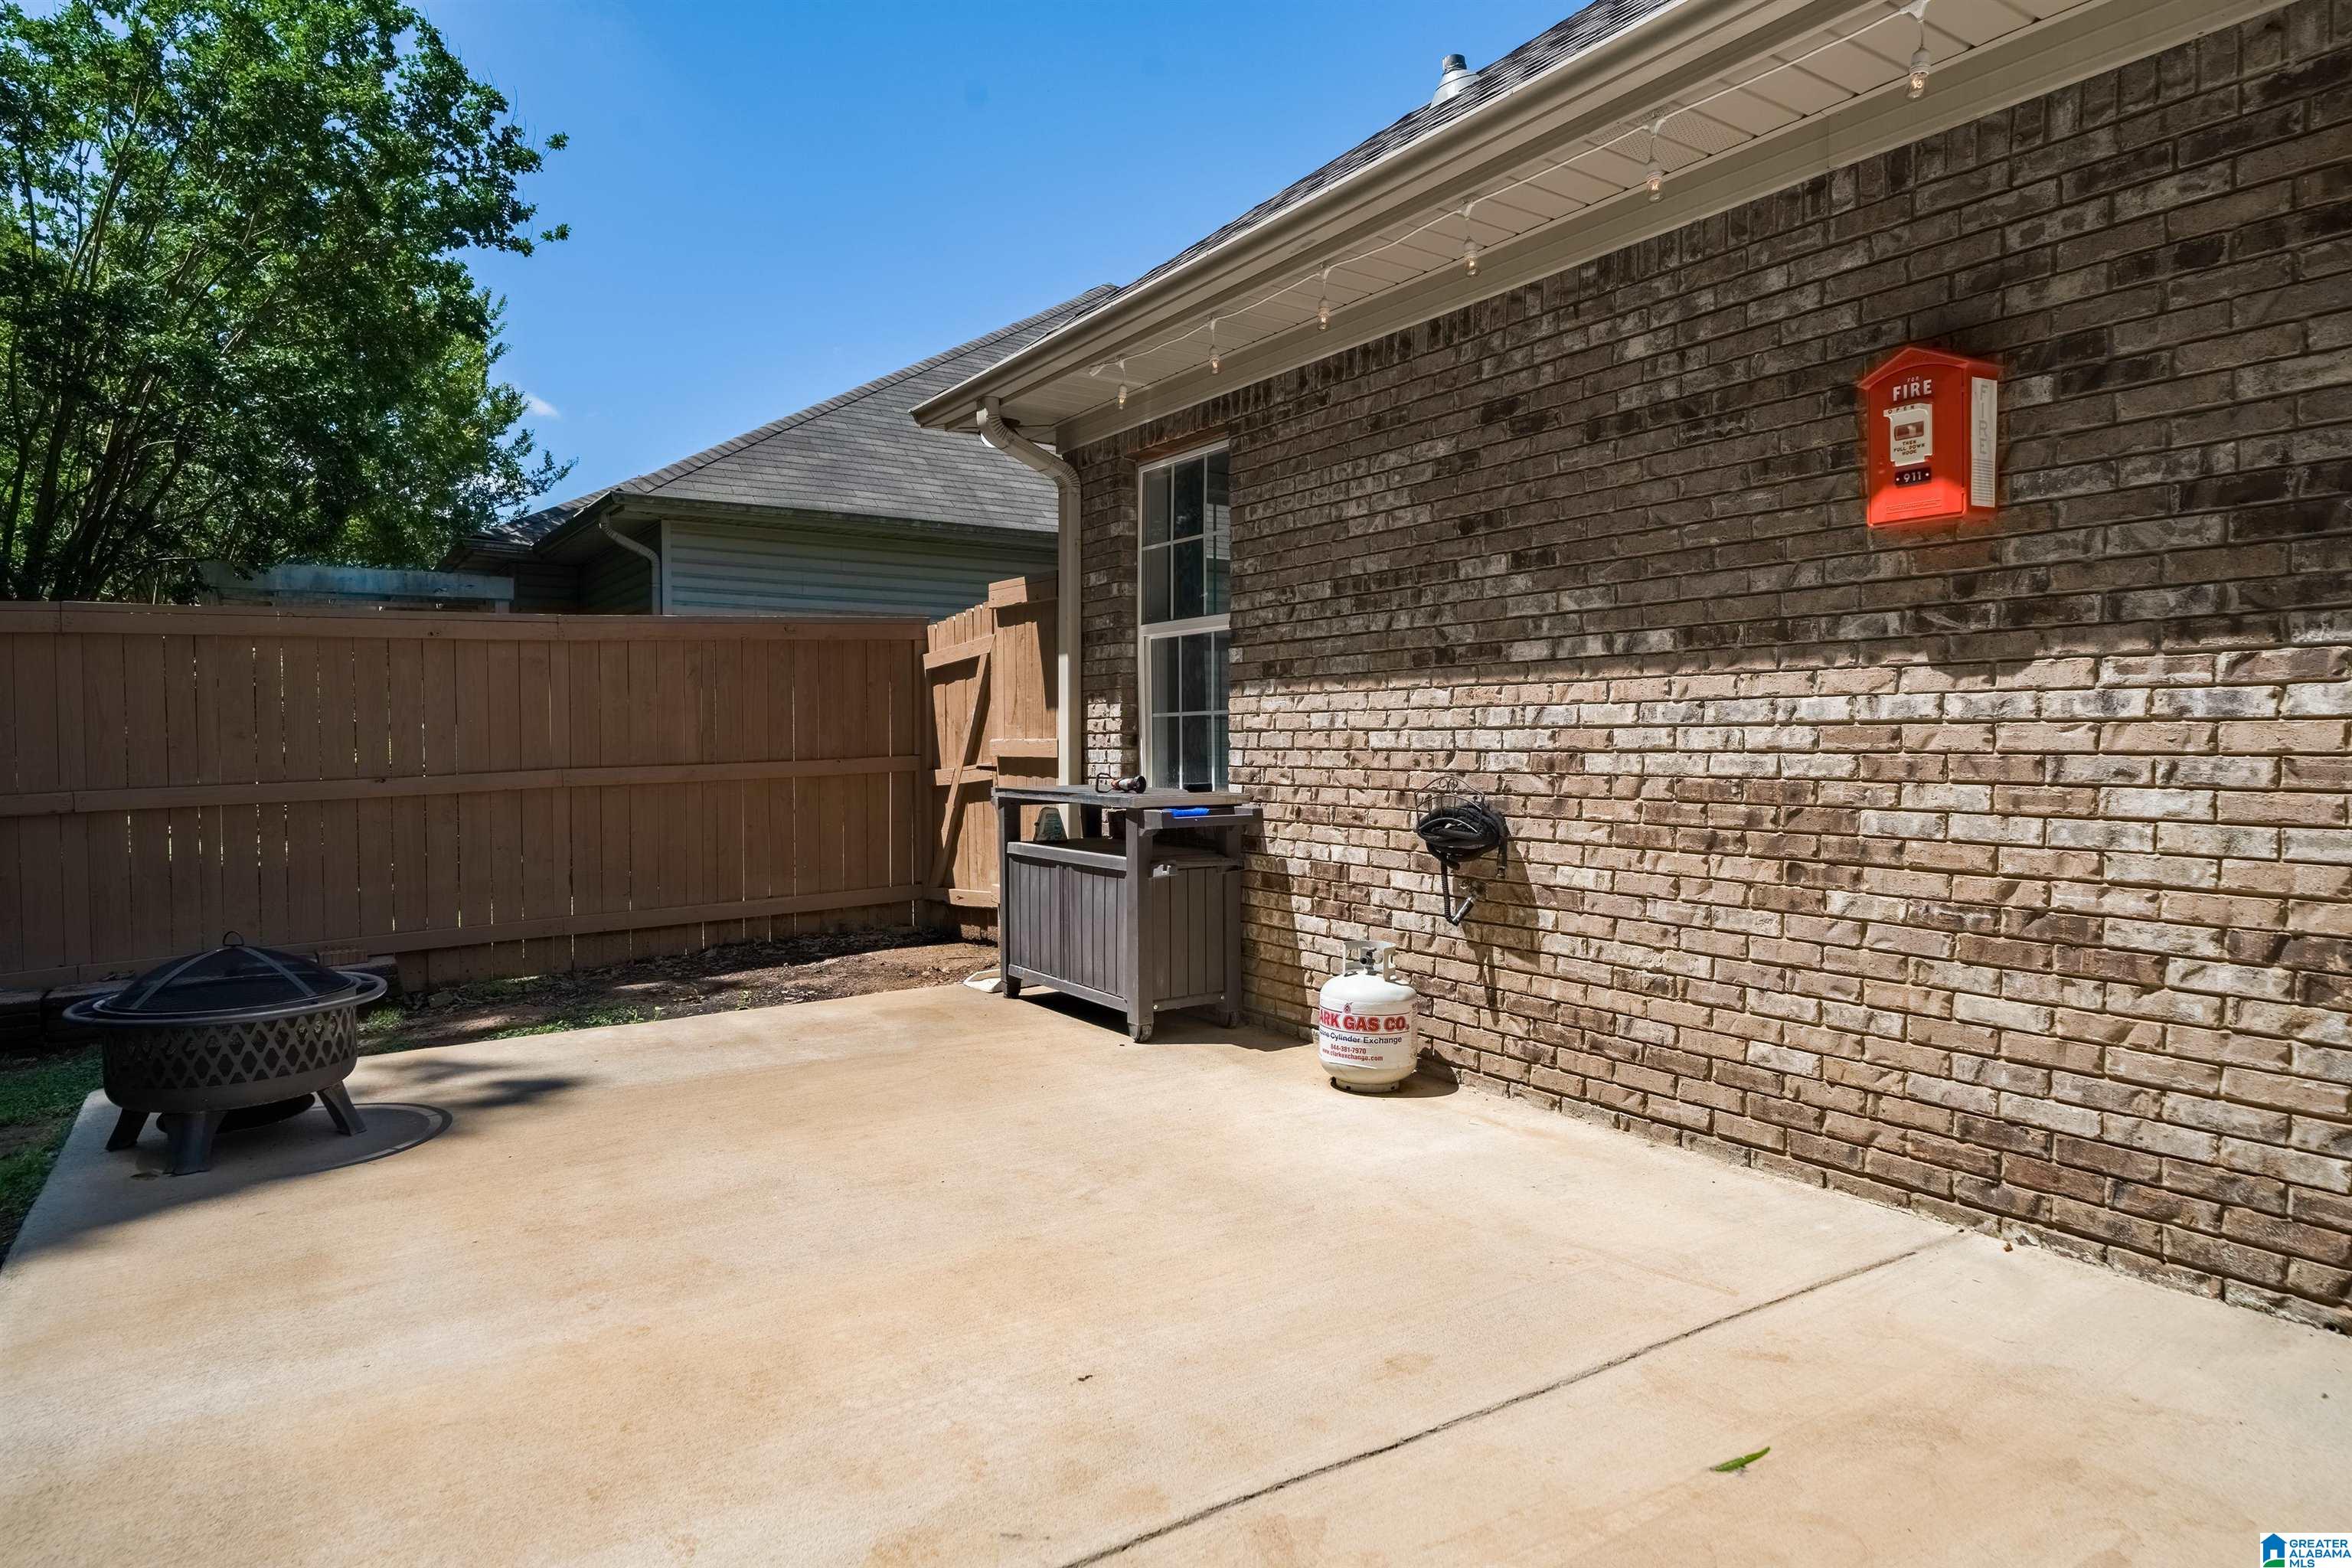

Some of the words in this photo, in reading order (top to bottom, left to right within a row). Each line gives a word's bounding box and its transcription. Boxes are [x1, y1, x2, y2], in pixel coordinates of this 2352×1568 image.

[1893, 379, 1932, 402] FIRE
[1887, 405, 1915, 414] OPEN
[1978, 384, 1988, 454] FIRE
[1903, 471, 1922, 482] 911
[1344, 1015, 1380, 1031] GAS
[1383, 1015, 1410, 1031] CO.
[1330, 1031, 1361, 1044] Cylinder
[1363, 1036, 1403, 1045] Exchange
